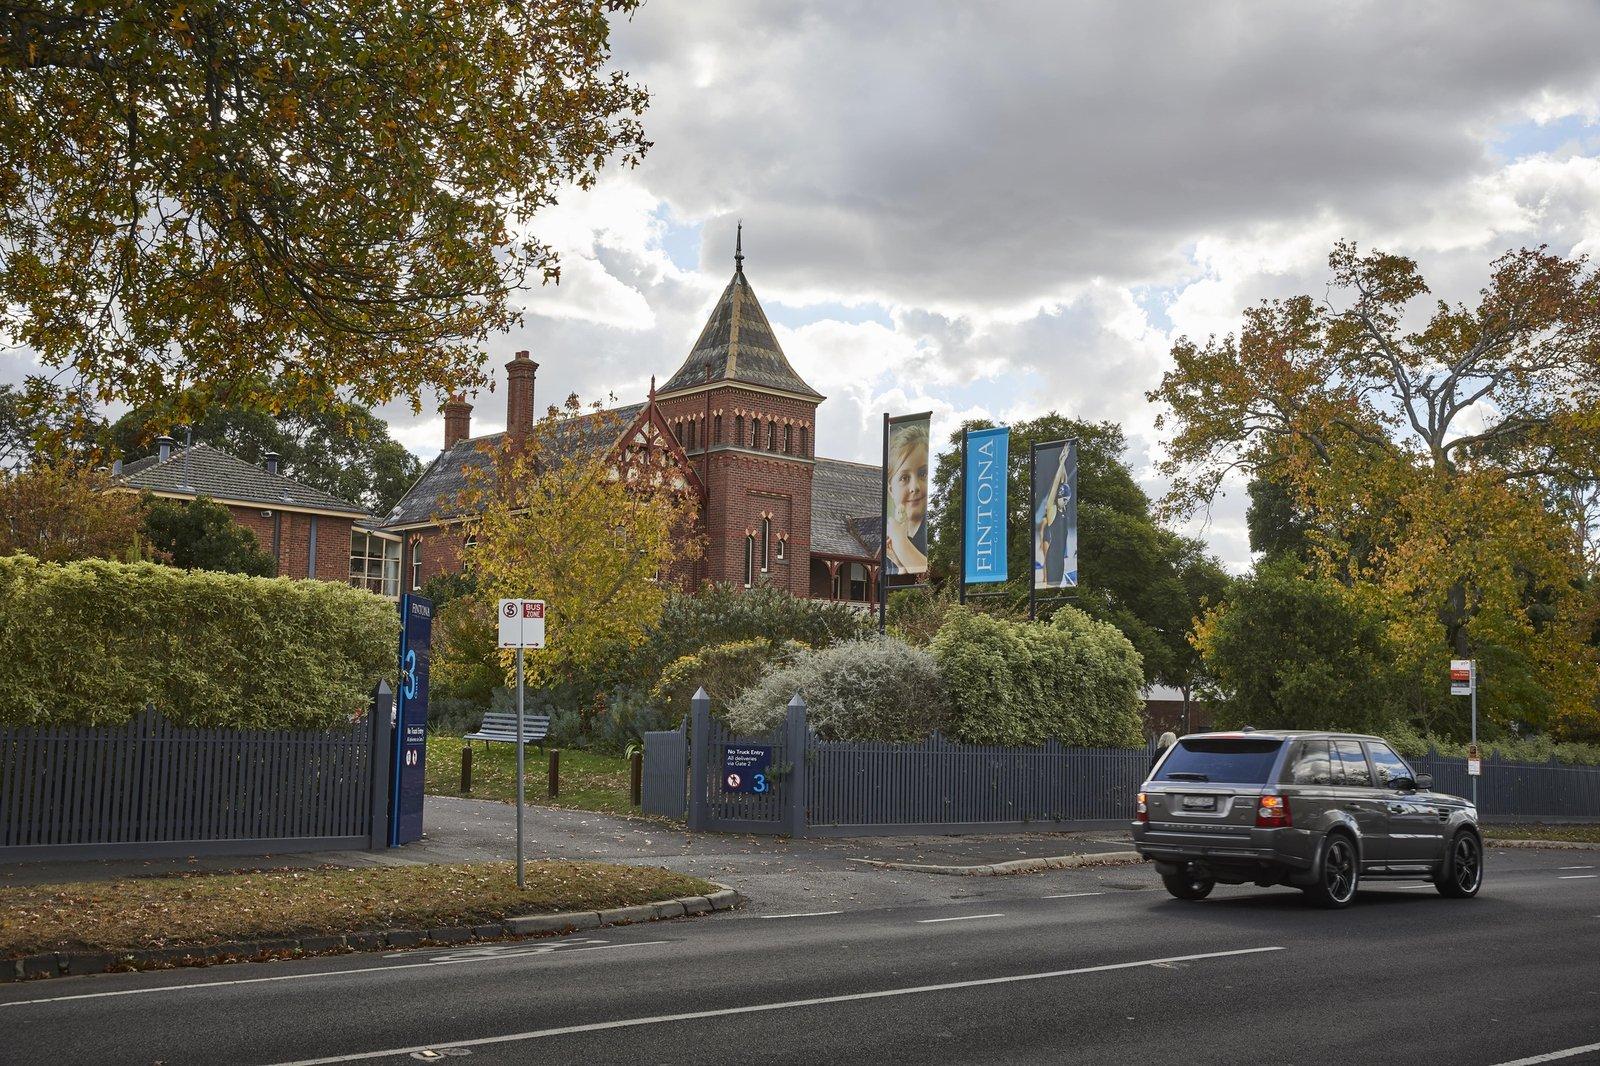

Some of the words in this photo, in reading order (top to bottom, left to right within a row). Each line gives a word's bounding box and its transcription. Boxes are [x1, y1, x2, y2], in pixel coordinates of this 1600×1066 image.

[977, 439, 994, 572] FINTONA
[404, 650, 415, 699] 3
[753, 774, 766, 792] 3
